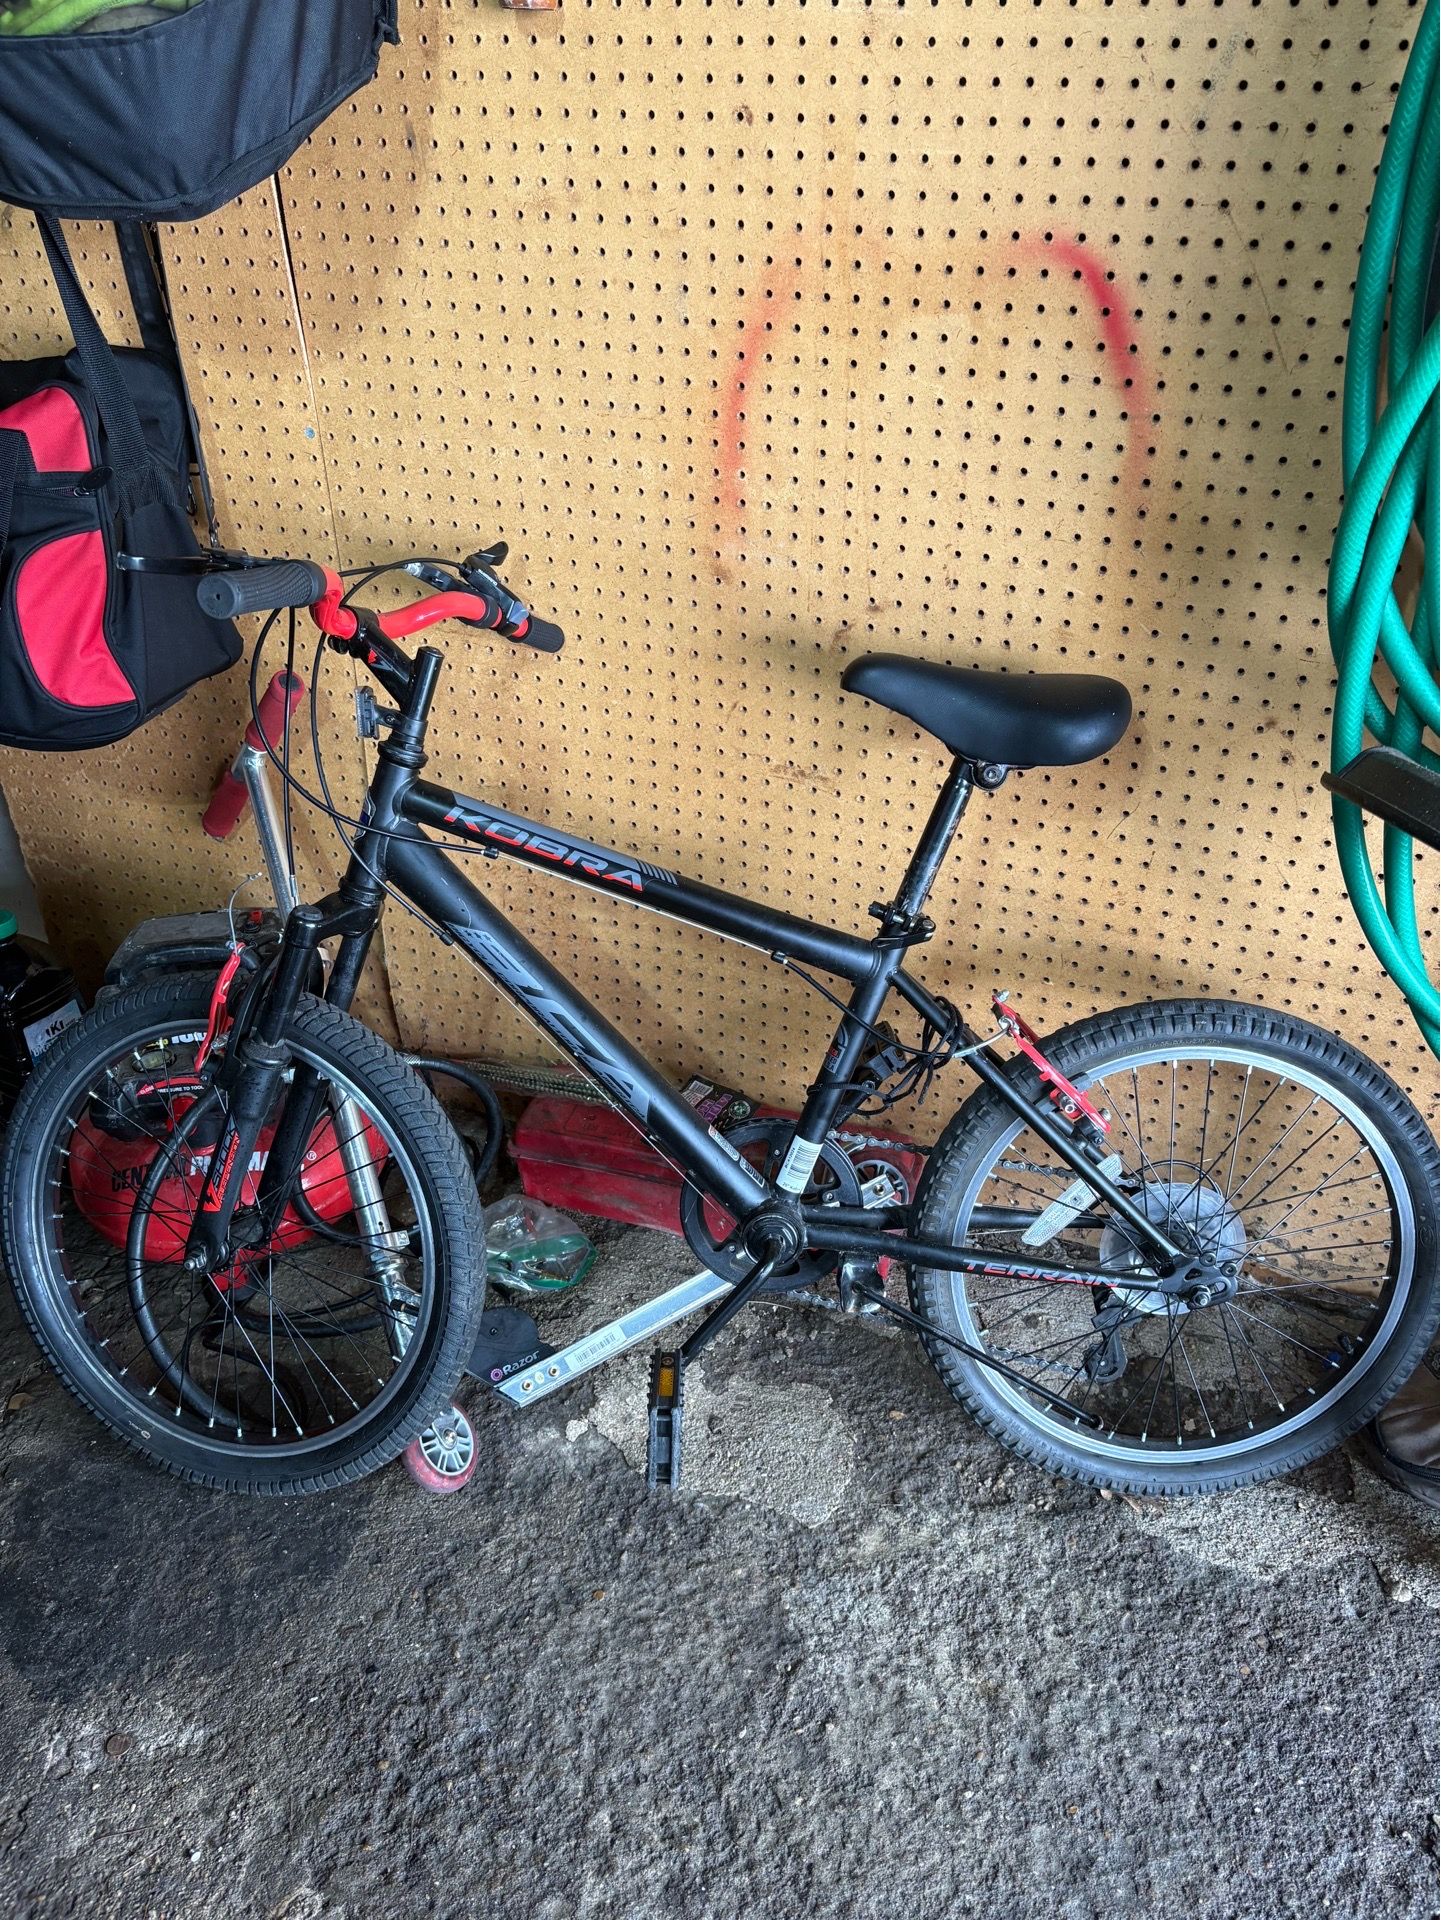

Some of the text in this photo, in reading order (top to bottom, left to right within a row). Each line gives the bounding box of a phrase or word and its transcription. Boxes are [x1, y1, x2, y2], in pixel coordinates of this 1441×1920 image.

[444, 806, 644, 892] KOBRA
[963, 1258, 1122, 1289] TERRAIN
[502, 1350, 541, 1377] Razor
